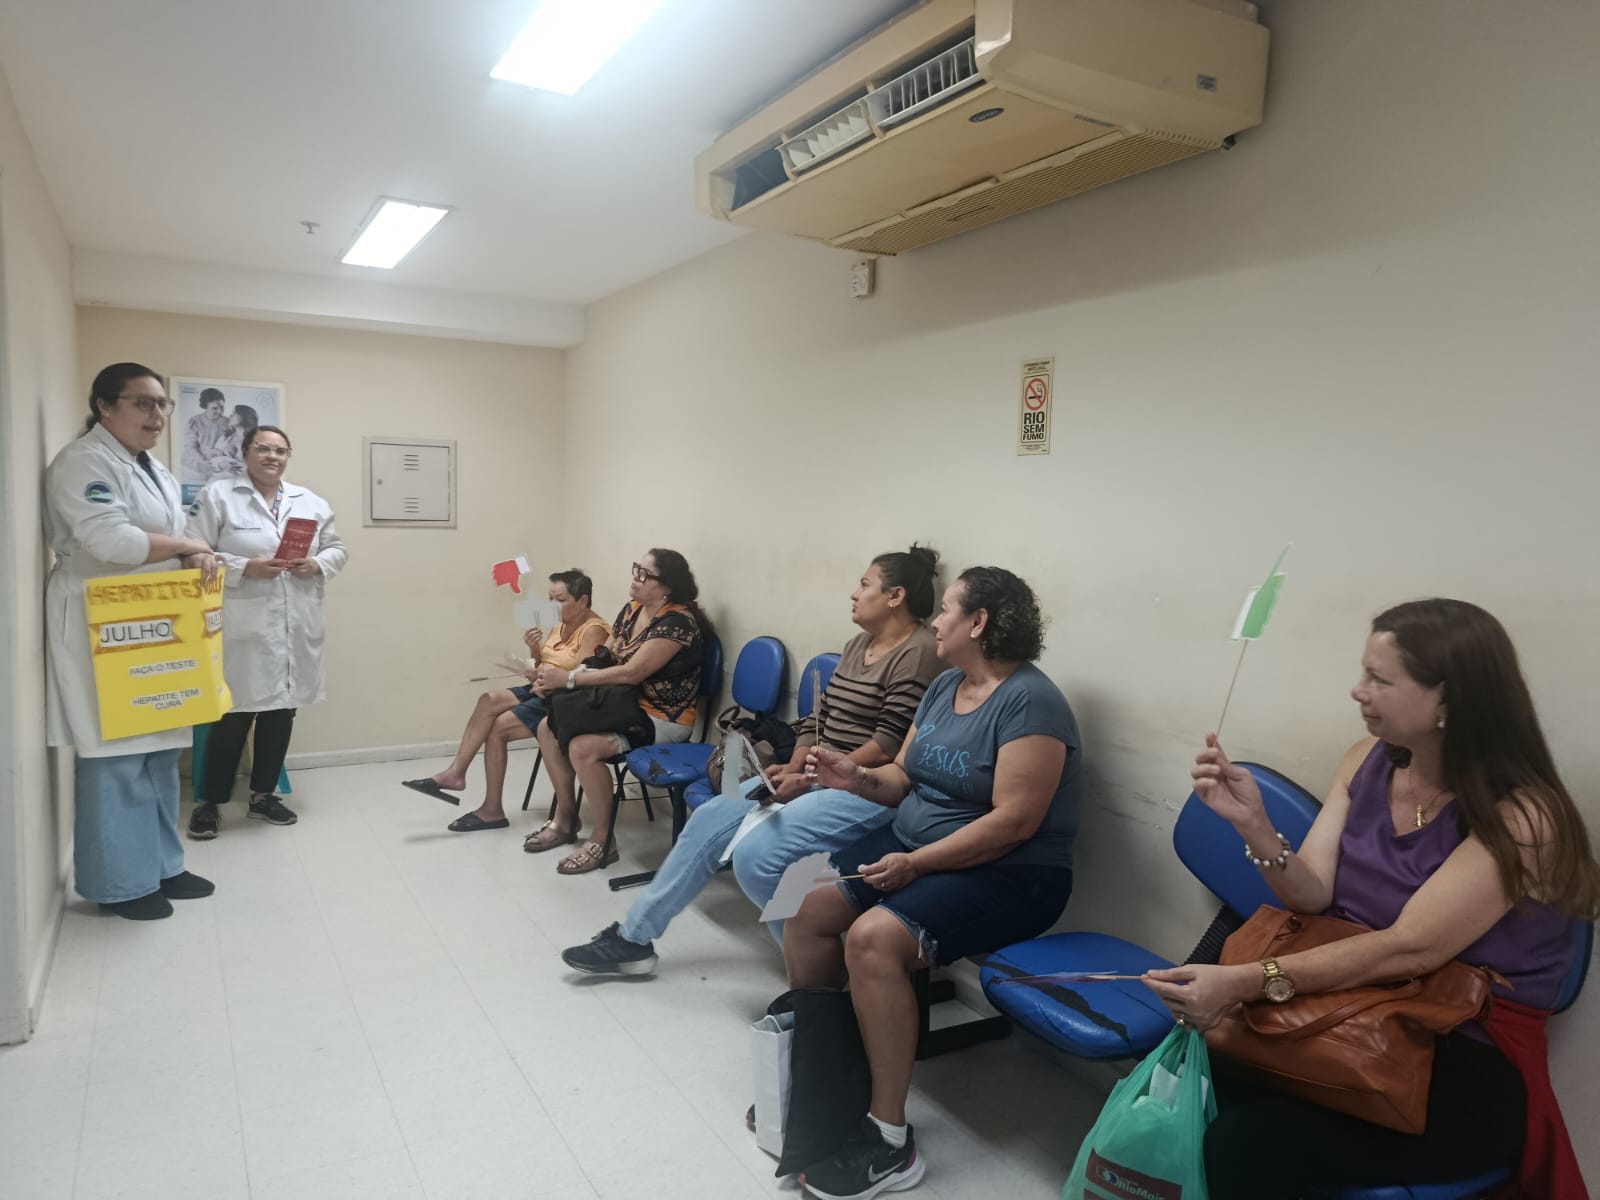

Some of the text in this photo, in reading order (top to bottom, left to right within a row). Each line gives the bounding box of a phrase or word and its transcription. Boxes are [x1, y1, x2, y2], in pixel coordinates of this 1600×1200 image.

[1024, 411, 1045, 425] RIO
[1023, 424, 1045, 434] SEM
[1023, 433, 1044, 441] FUMO
[100, 622, 170, 643] JULHO
[129, 659, 196, 675] FAÇA O TESTE
[132, 688, 199, 705] HEPATITE TEM
[155, 699, 182, 710] CURA
